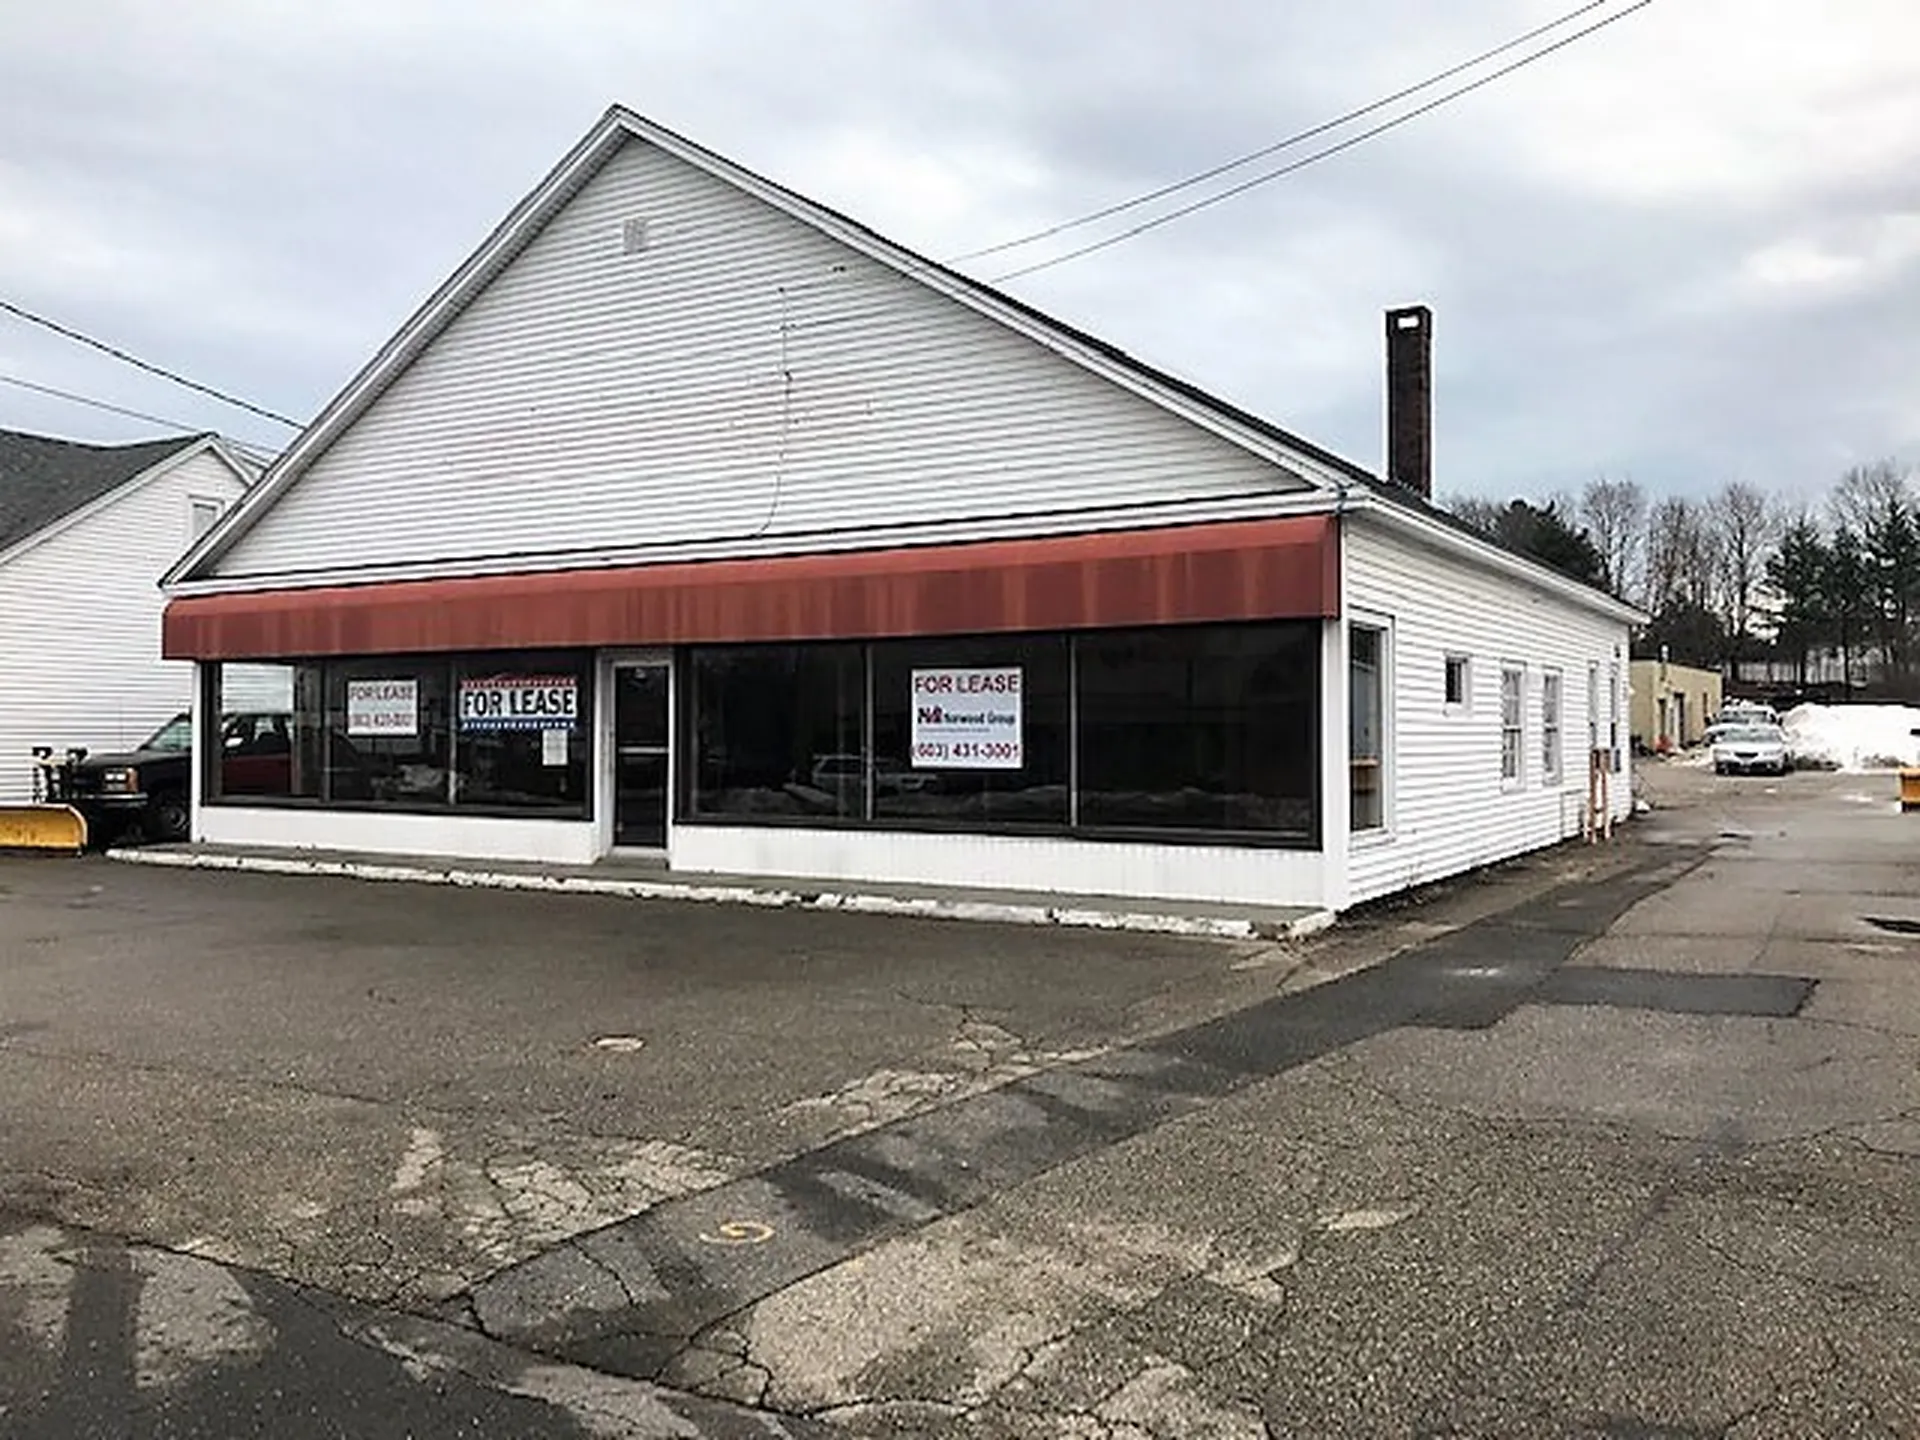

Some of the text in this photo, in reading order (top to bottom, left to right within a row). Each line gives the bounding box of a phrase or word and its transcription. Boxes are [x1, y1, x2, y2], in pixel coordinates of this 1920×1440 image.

[351, 685, 414, 701] FOR LEASE
[915, 673, 1019, 694] FOR LEASE
[464, 688, 574, 715] FOR LEASE
